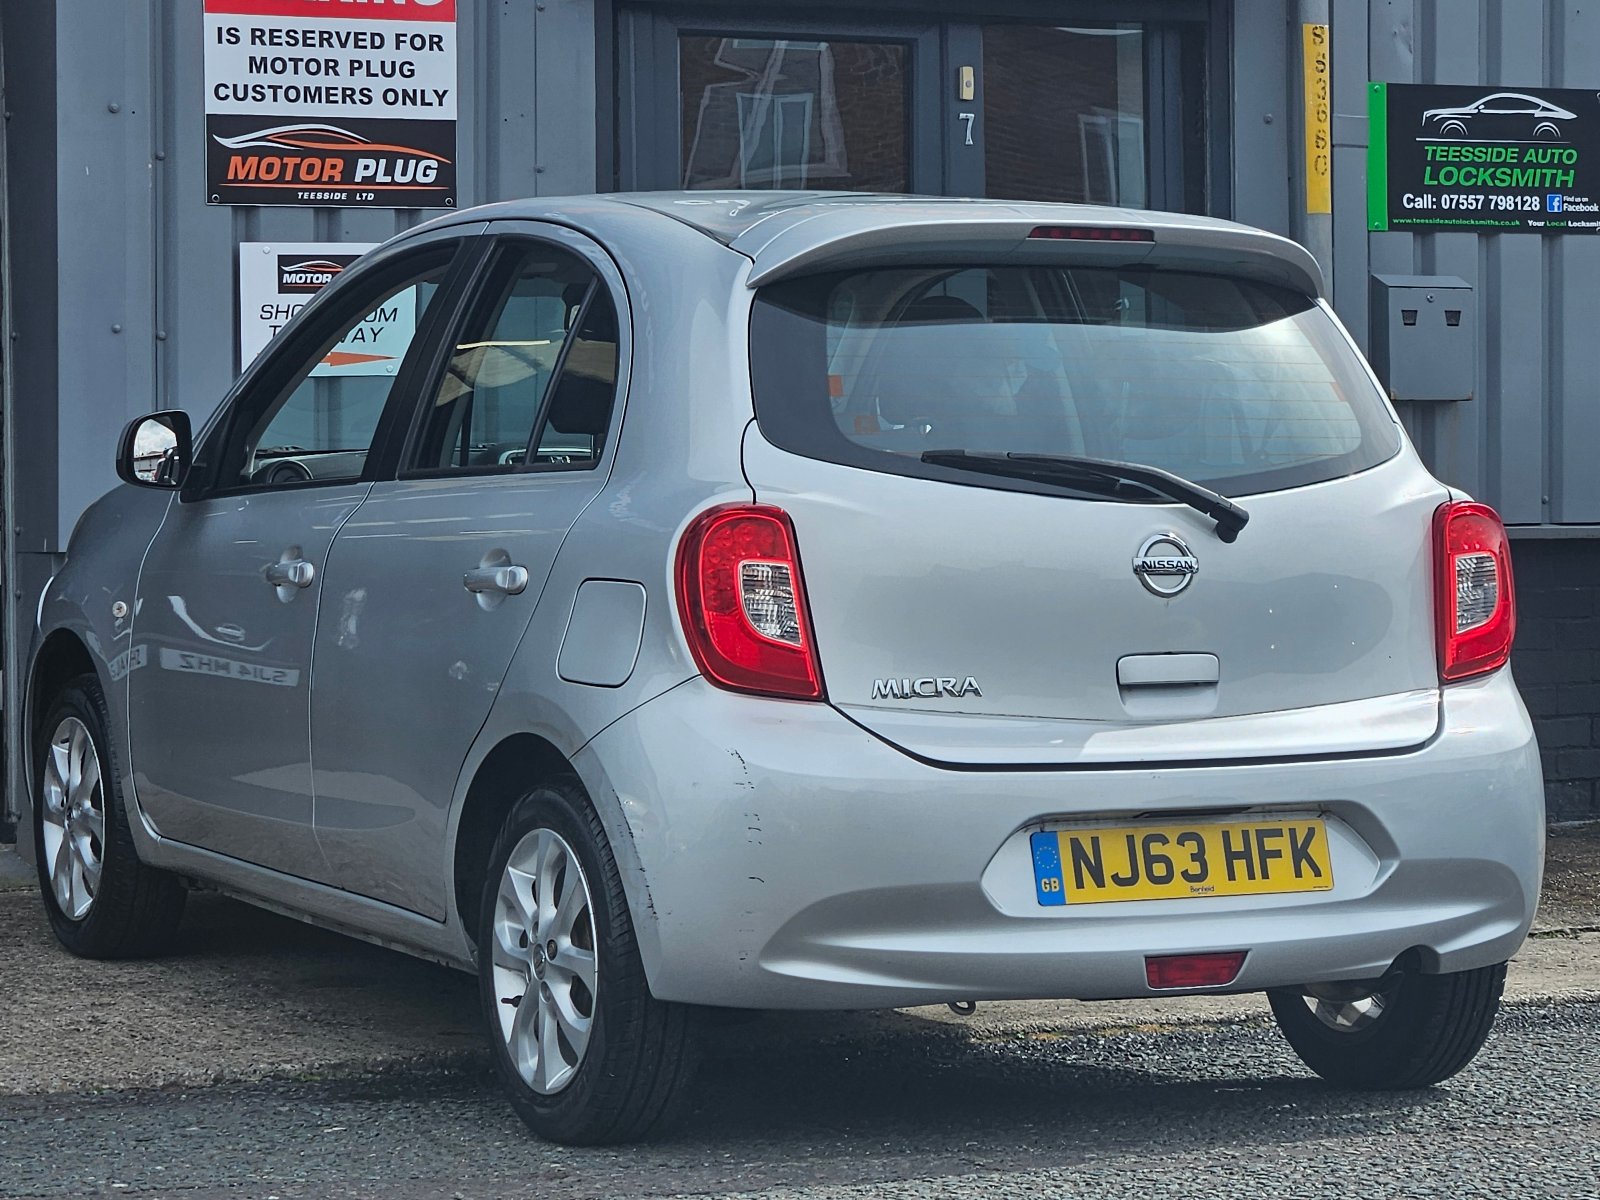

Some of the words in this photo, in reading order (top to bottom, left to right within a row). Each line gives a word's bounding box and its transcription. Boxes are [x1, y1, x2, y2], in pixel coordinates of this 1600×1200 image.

[216, 26, 241, 45] IS
[250, 27, 386, 50] RESERVED
[394, 33, 445, 52] FOR
[248, 56, 340, 77] MOTOR
[349, 59, 416, 79] PLUG
[213, 82, 373, 106] CUSTOMERS
[382, 88, 449, 107] ONLY
[959, 113, 975, 145] 7
[1423, 146, 1518, 163] TEESSIDE
[1523, 149, 1578, 165] AUTO
[227, 156, 344, 182] MOTOR
[354, 158, 439, 183] PLUG
[1423, 166, 1575, 188] LOCKSMITH
[297, 192, 347, 201] TEESSIDE
[356, 193, 375, 201] LTD
[1402, 193, 1437, 209] Call:
[1441, 194, 1485, 210] 07557
[1488, 195, 1541, 211] 798128
[1563, 203, 1600, 212] Facebook
[1528, 219, 1545, 227] Your
[283, 273, 331, 284] MOTOR
[1142, 560, 1193, 570] NISSAN
[872, 676, 983, 699] MICRA
[1069, 831, 1210, 890] NJ63
[1221, 826, 1323, 882] HFK
[1041, 877, 1060, 893] GB
